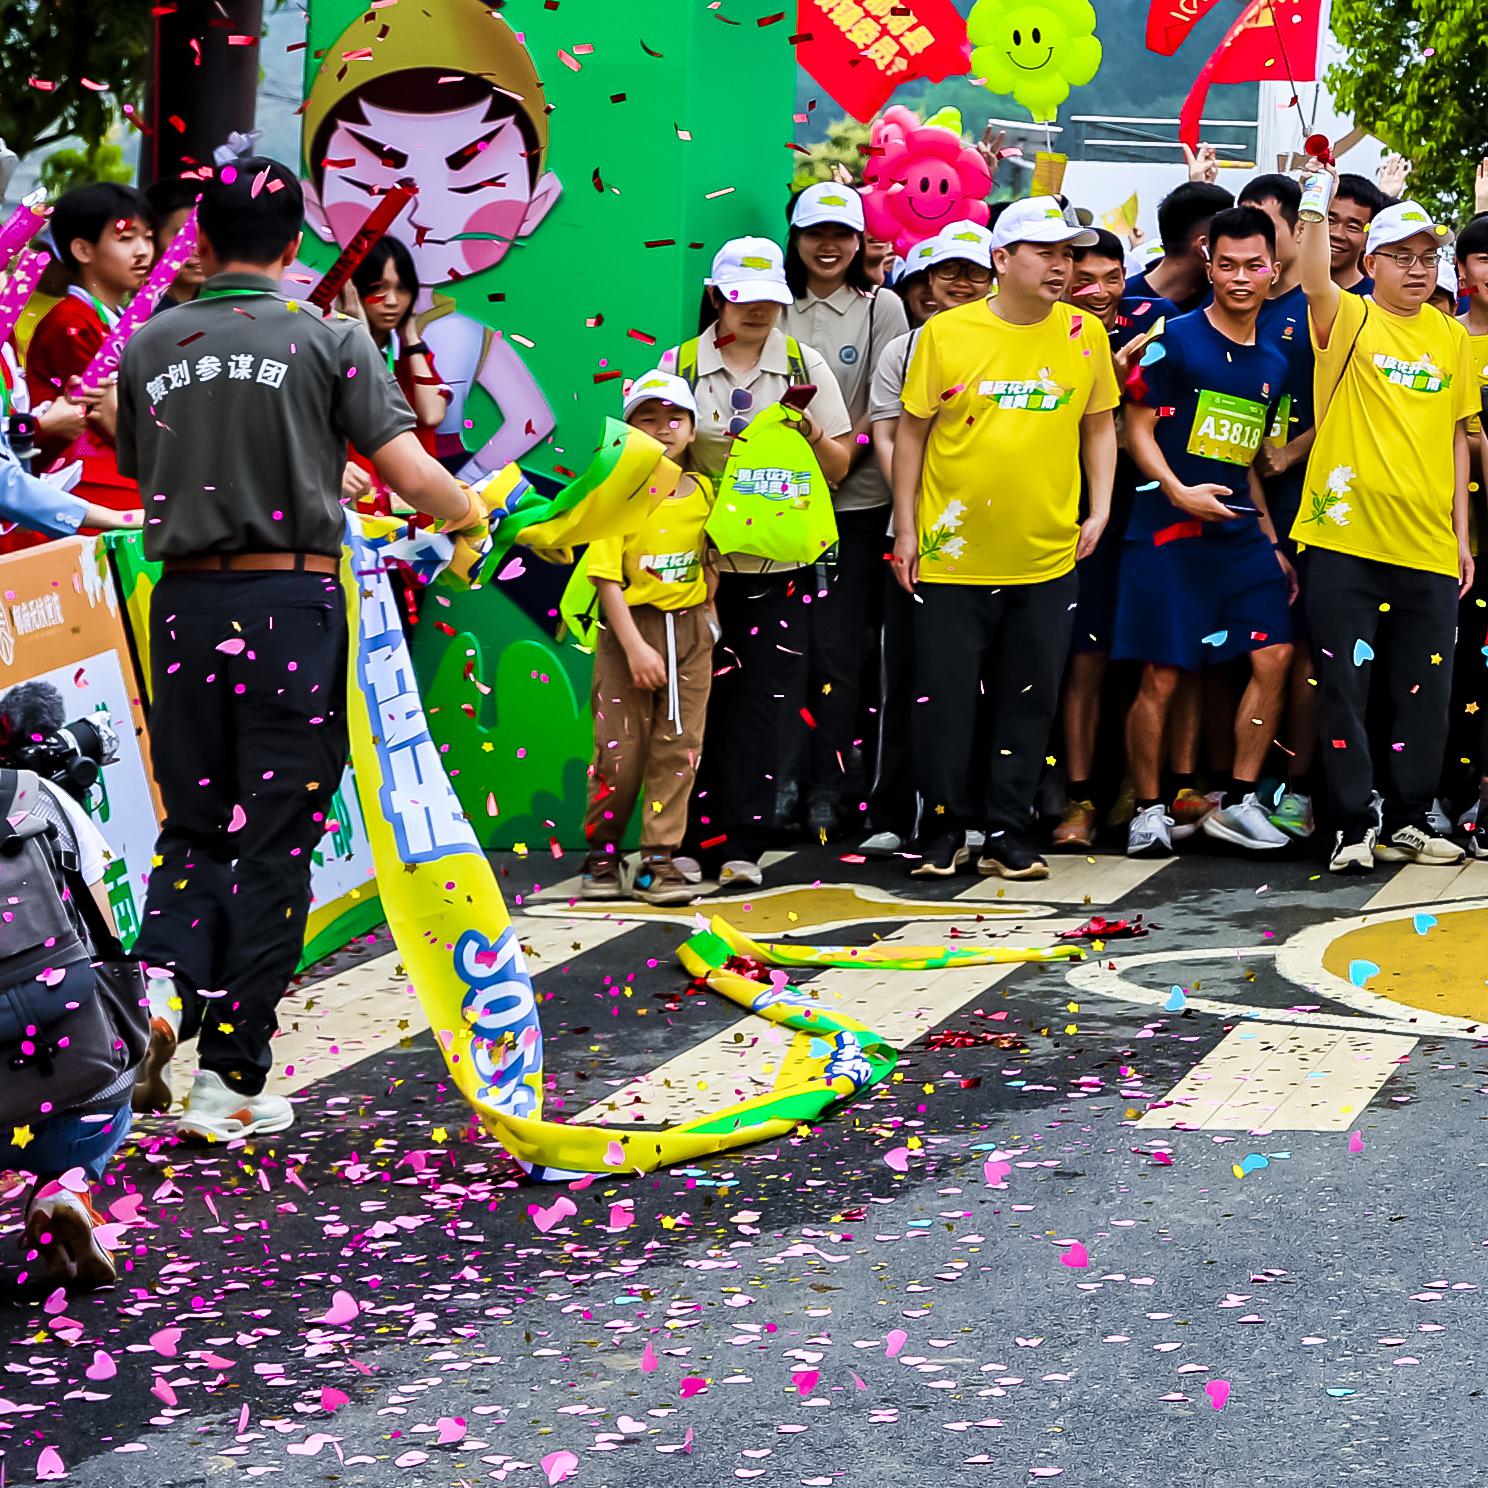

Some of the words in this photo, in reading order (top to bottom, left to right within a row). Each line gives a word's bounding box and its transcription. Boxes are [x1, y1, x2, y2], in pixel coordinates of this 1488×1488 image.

[146, 353, 289, 405] 策划参谋团
[1197, 415, 1262, 450] A3818
